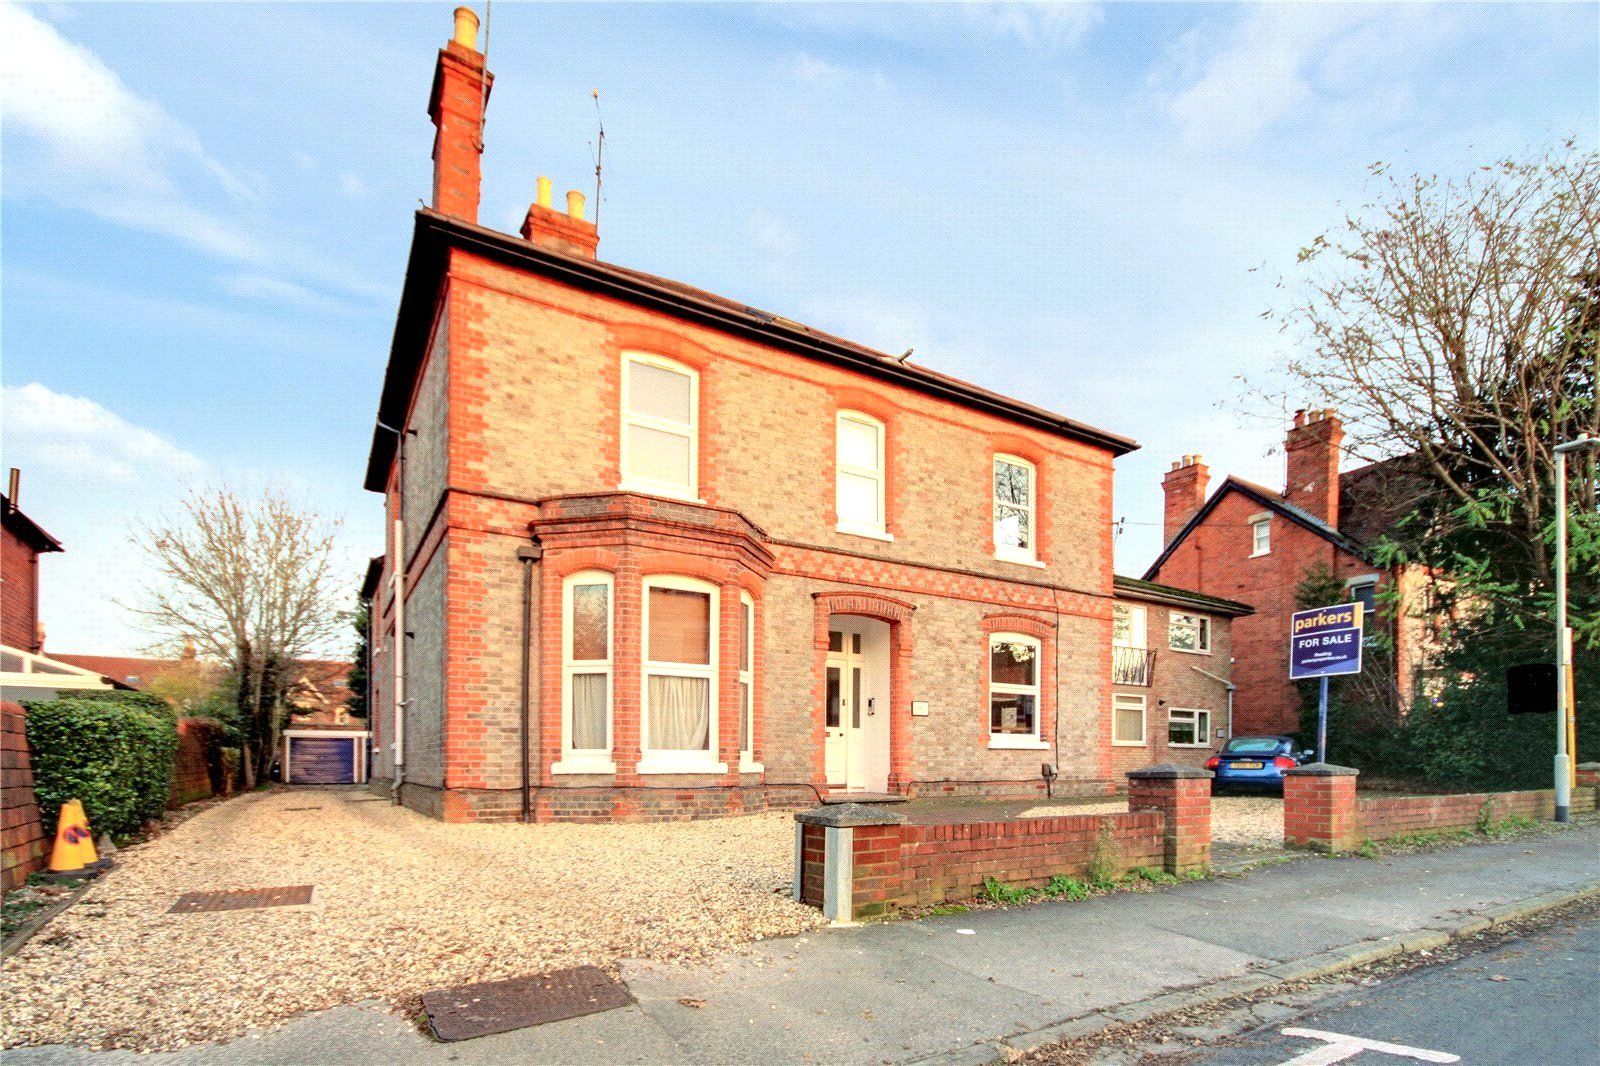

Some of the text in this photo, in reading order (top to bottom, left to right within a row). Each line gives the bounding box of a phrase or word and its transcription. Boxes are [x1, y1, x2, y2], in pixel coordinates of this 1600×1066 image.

[1295, 612, 1352, 633] parkers
[1299, 634, 1352, 648] FOR SALE
